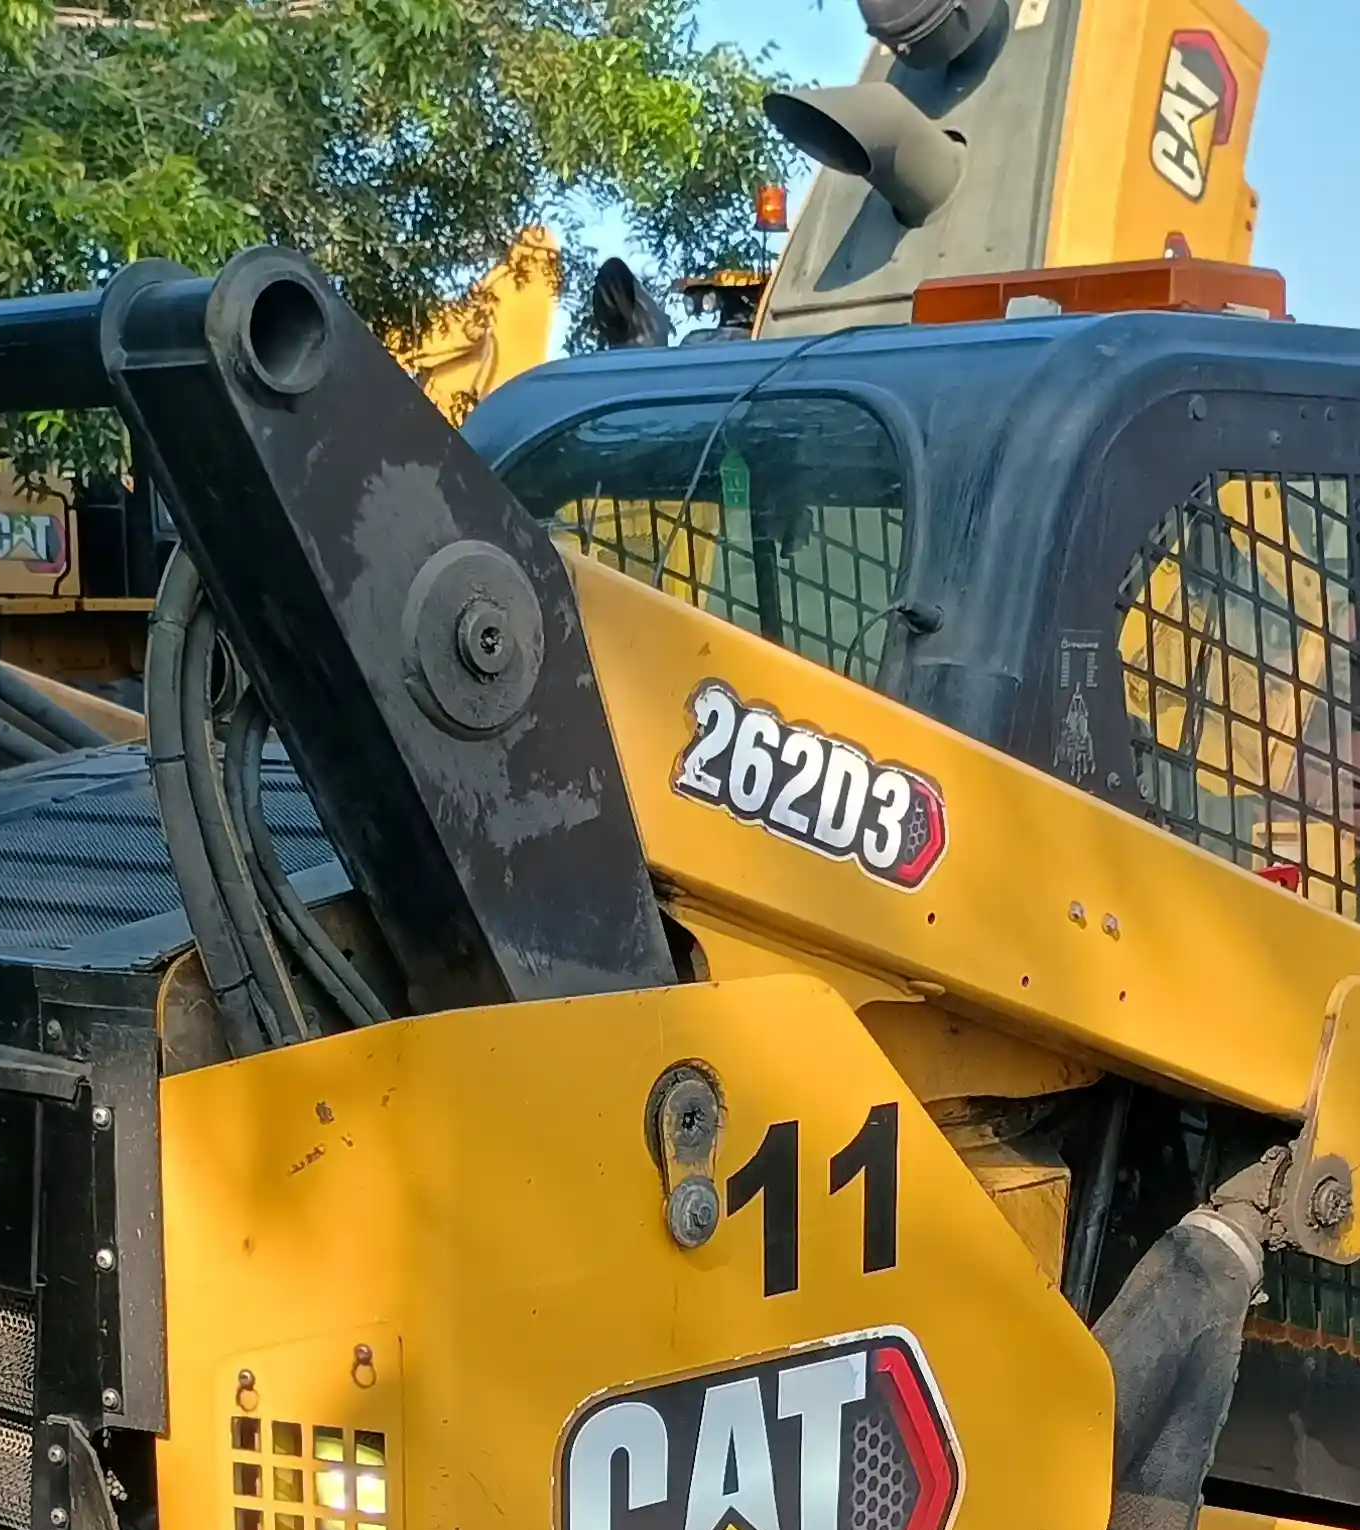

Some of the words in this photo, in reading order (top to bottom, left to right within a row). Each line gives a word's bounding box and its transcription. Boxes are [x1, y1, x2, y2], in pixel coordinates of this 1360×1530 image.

[1152, 44, 1220, 201] CAT
[674, 683, 912, 869] 262D3
[726, 1101, 900, 1299] 11
